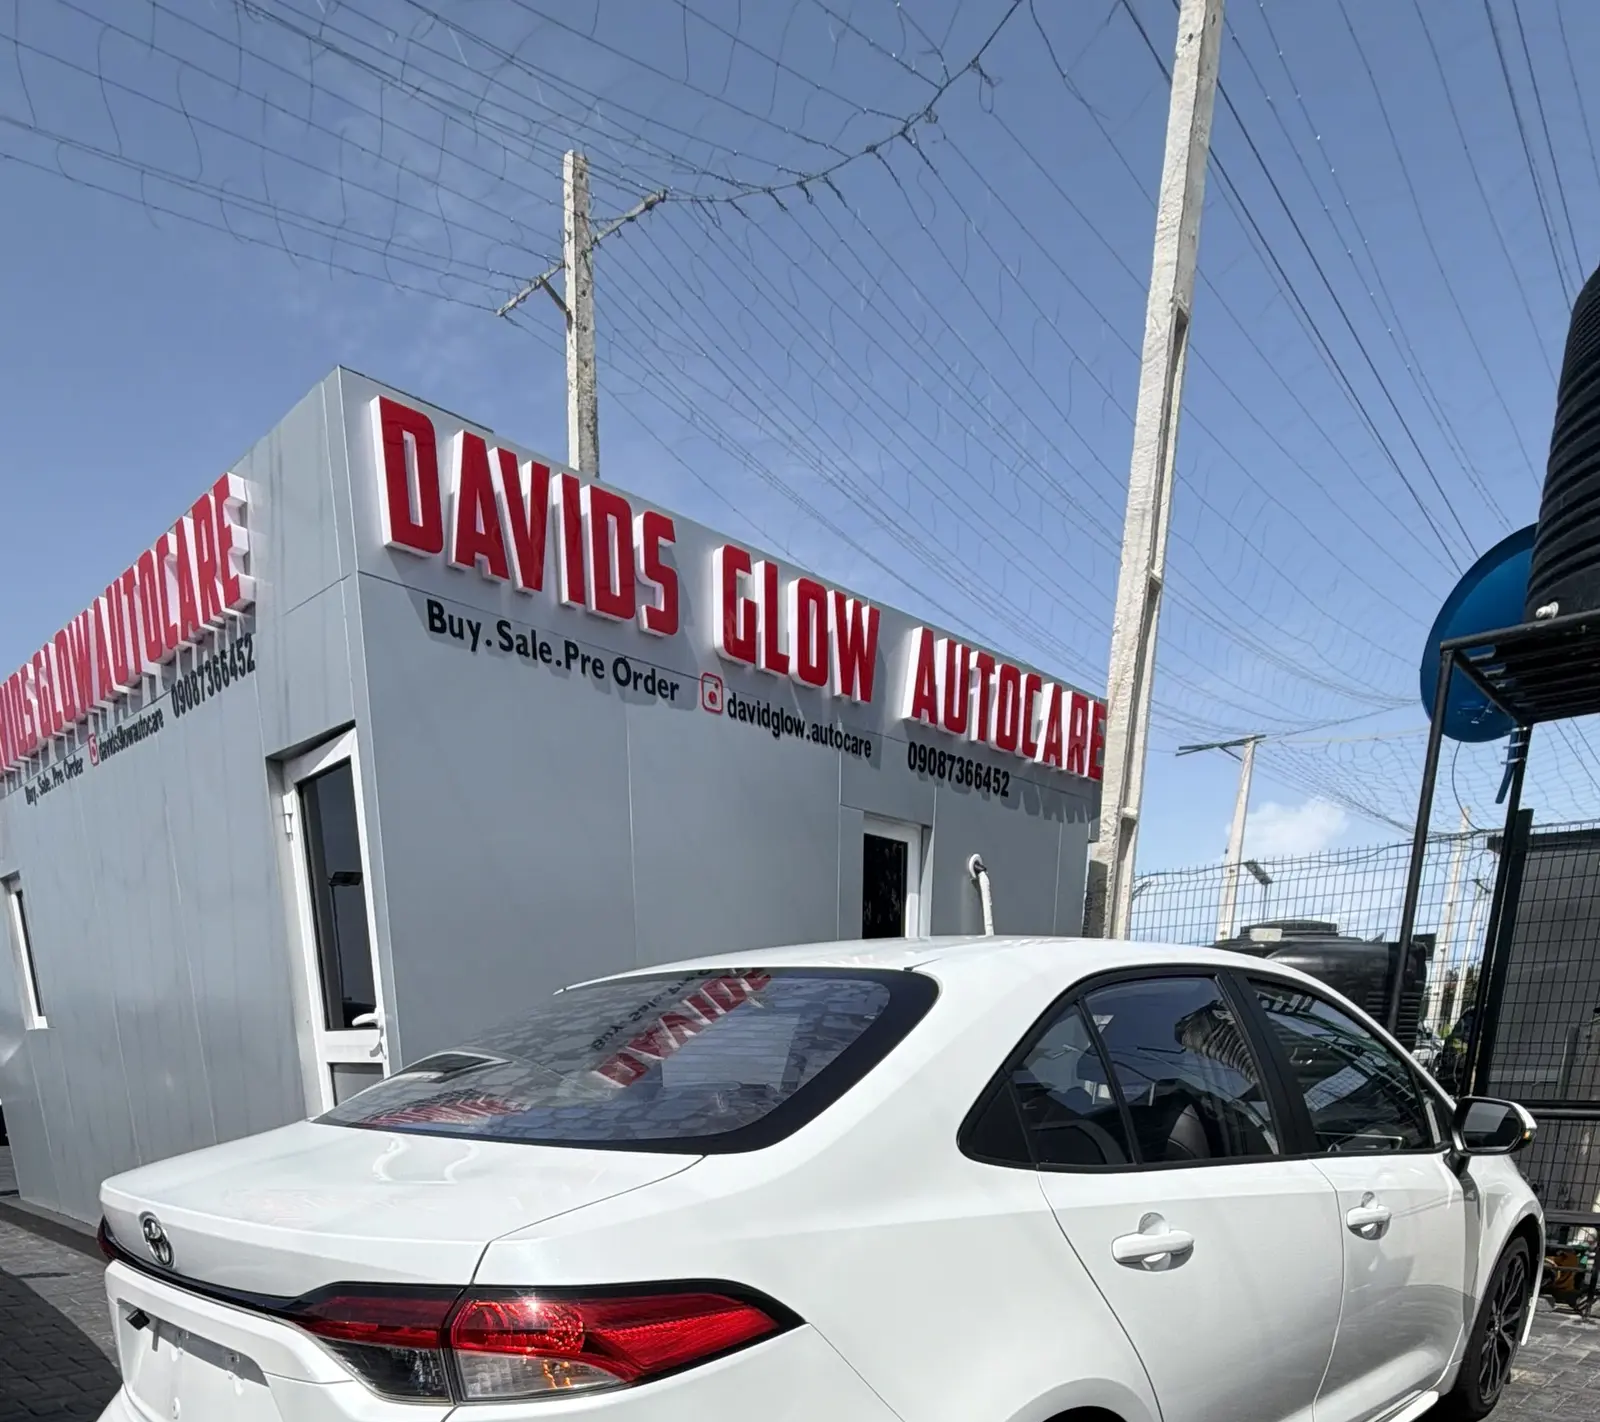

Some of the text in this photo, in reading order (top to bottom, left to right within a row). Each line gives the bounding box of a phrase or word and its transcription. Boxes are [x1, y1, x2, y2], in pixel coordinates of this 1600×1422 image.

[33, 608, 97, 738] GLOW
[93, 472, 254, 702] AUTOCARE
[370, 394, 1107, 781] DAVIDS GLOW AUTOCARE
[171, 631, 256, 719] 09087366452
[612, 655, 680, 702] Order
[727, 692, 872, 759] davidglow.autocare
[907, 741, 1010, 798] 09087366452
